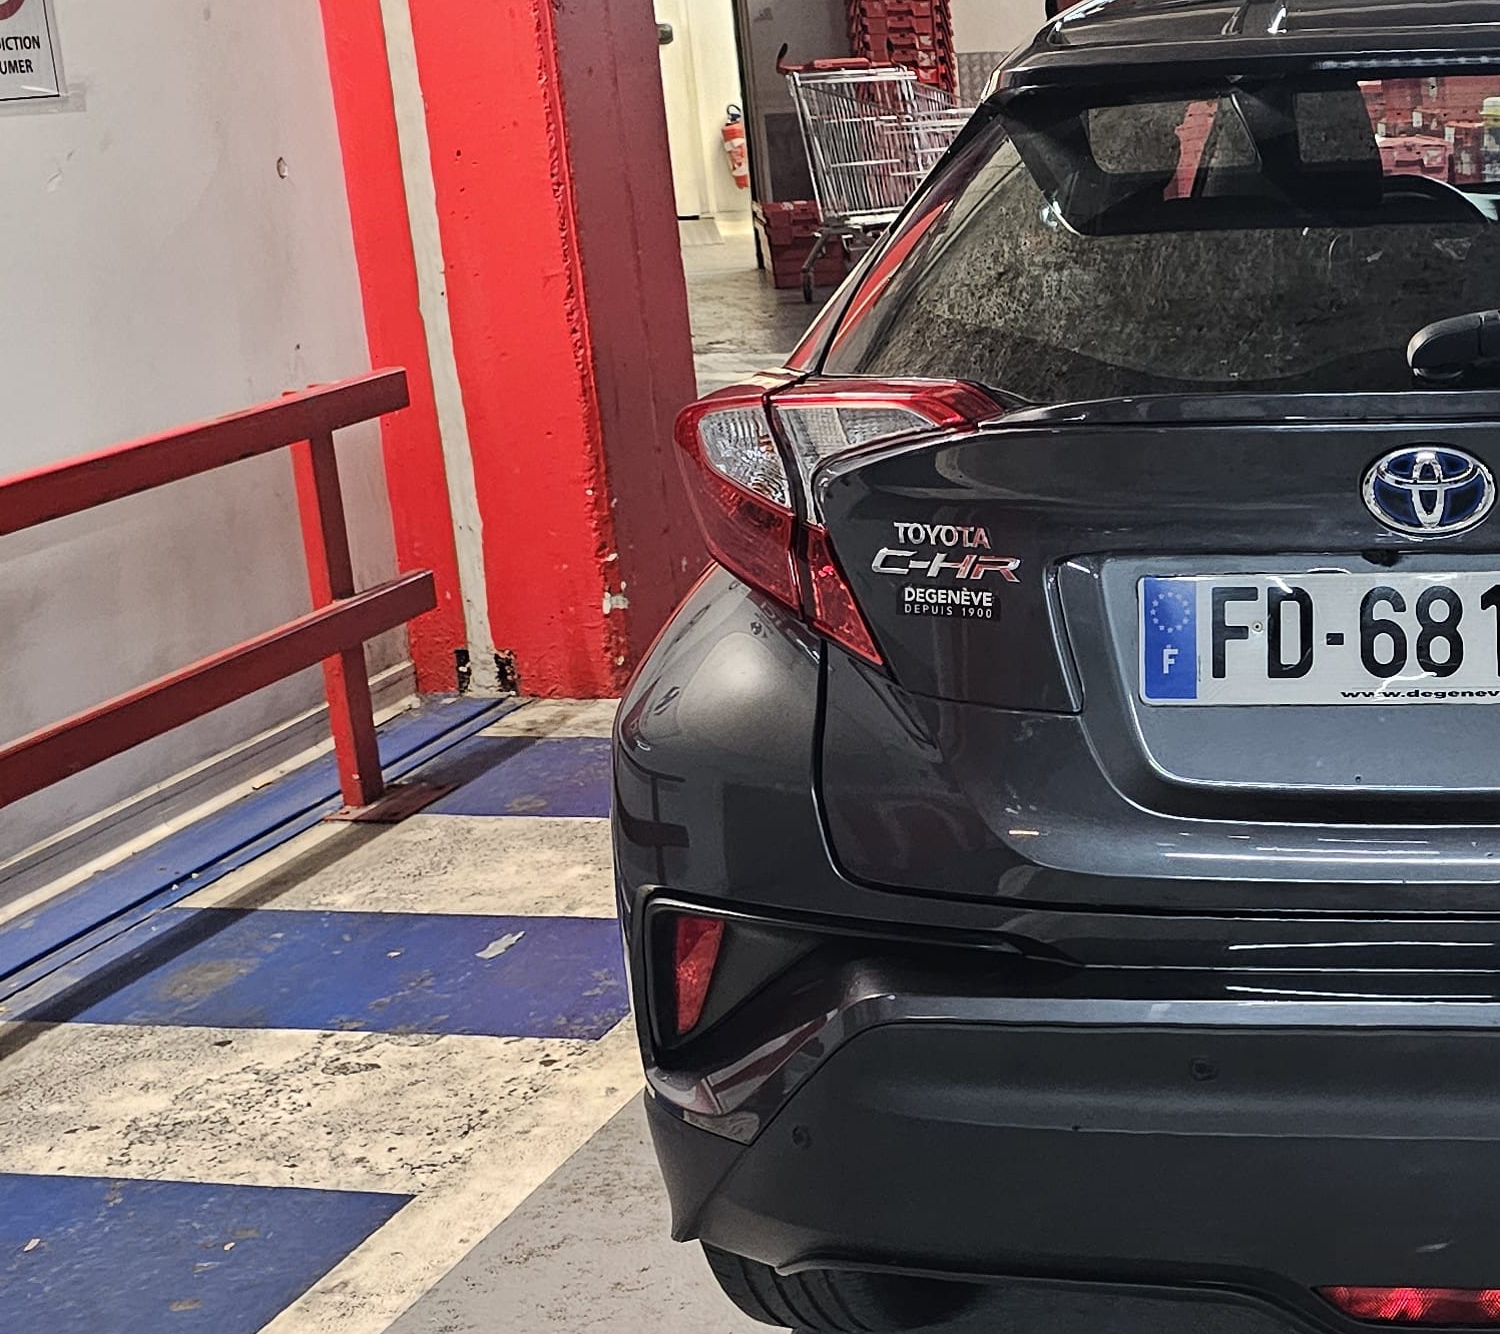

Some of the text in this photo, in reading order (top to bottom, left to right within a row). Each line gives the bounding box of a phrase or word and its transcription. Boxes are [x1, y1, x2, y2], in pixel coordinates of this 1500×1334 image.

[0, 35, 41, 51] ICTION
[893, 521, 991, 550] TOYOTA
[871, 547, 1021, 583] C-HR
[904, 586, 993, 607] DEGENÈVE
[904, 604, 992, 618] DEPUIS 1900
[1163, 648, 1179, 674] F
